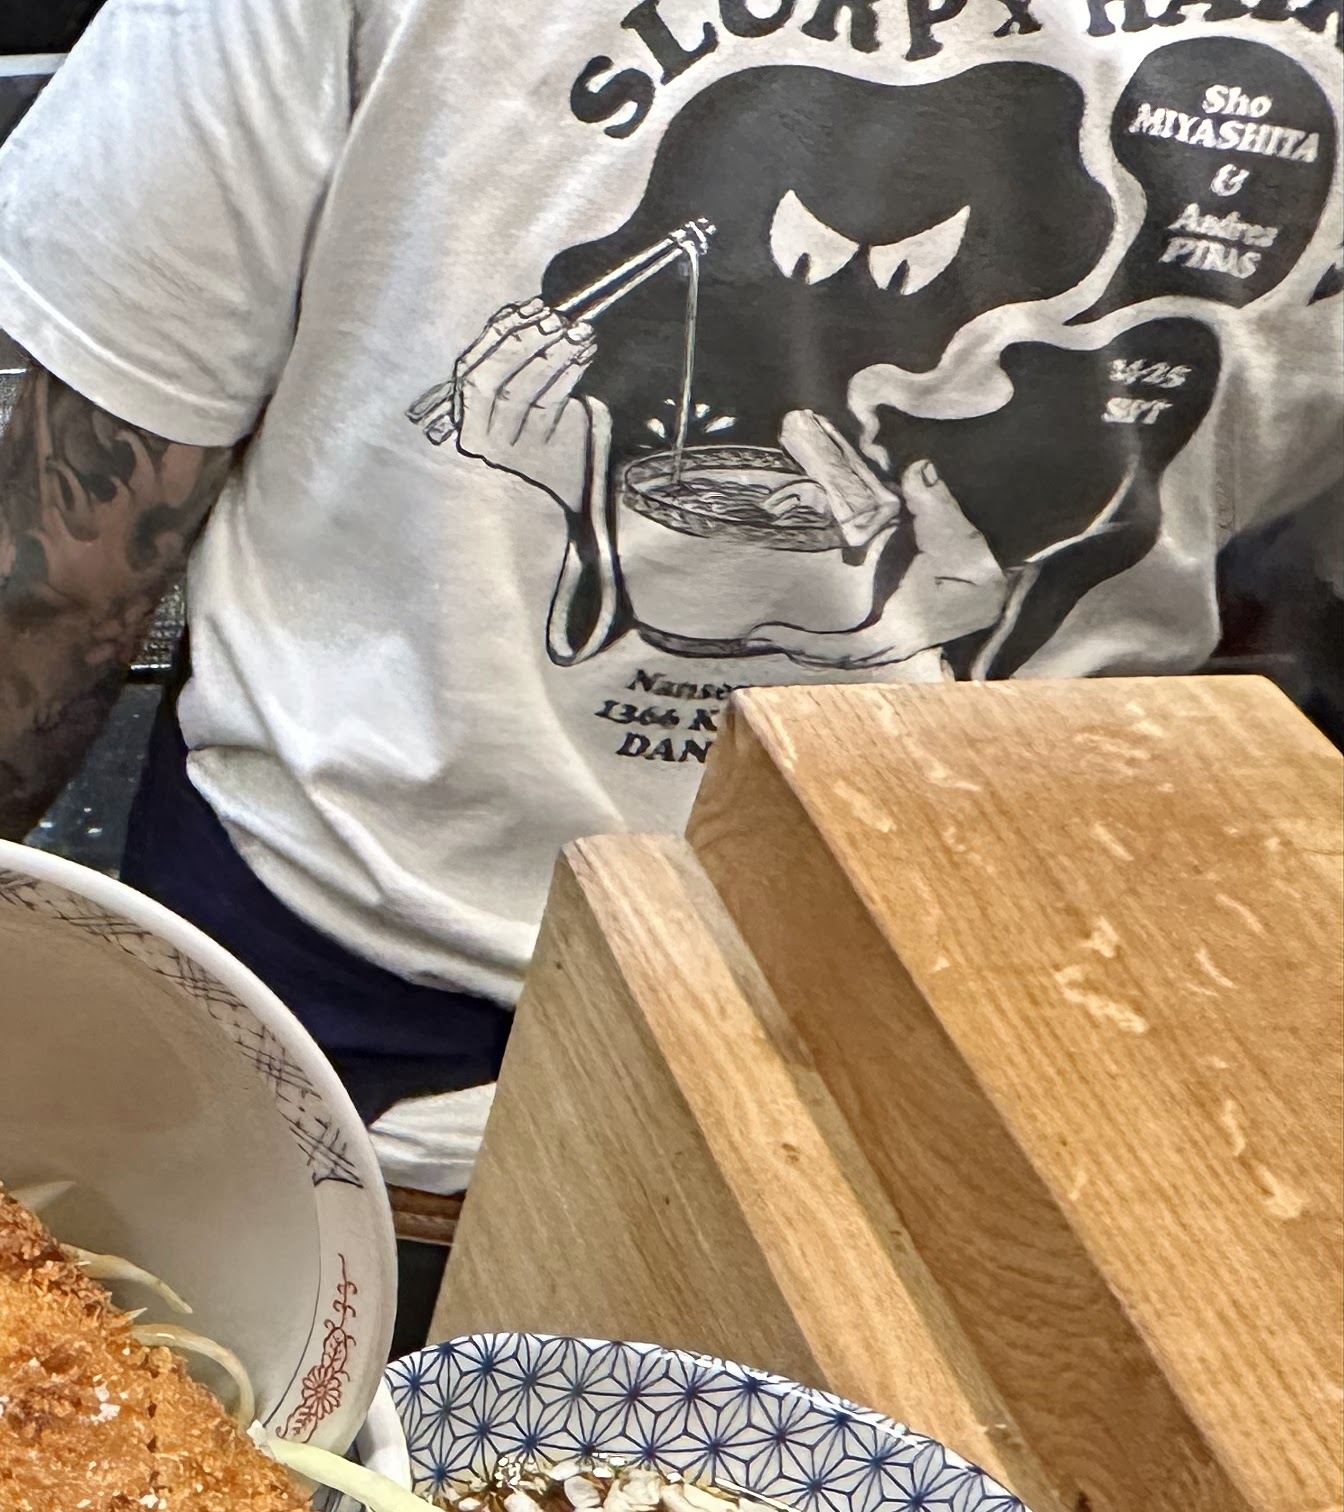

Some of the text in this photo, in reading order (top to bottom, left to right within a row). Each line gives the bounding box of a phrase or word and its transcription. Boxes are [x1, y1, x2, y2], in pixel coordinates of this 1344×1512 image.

[570, 0, 967, 139] SLURP
[1202, 84, 1273, 118] Sho
[1127, 103, 1320, 163] MIYASHITA
